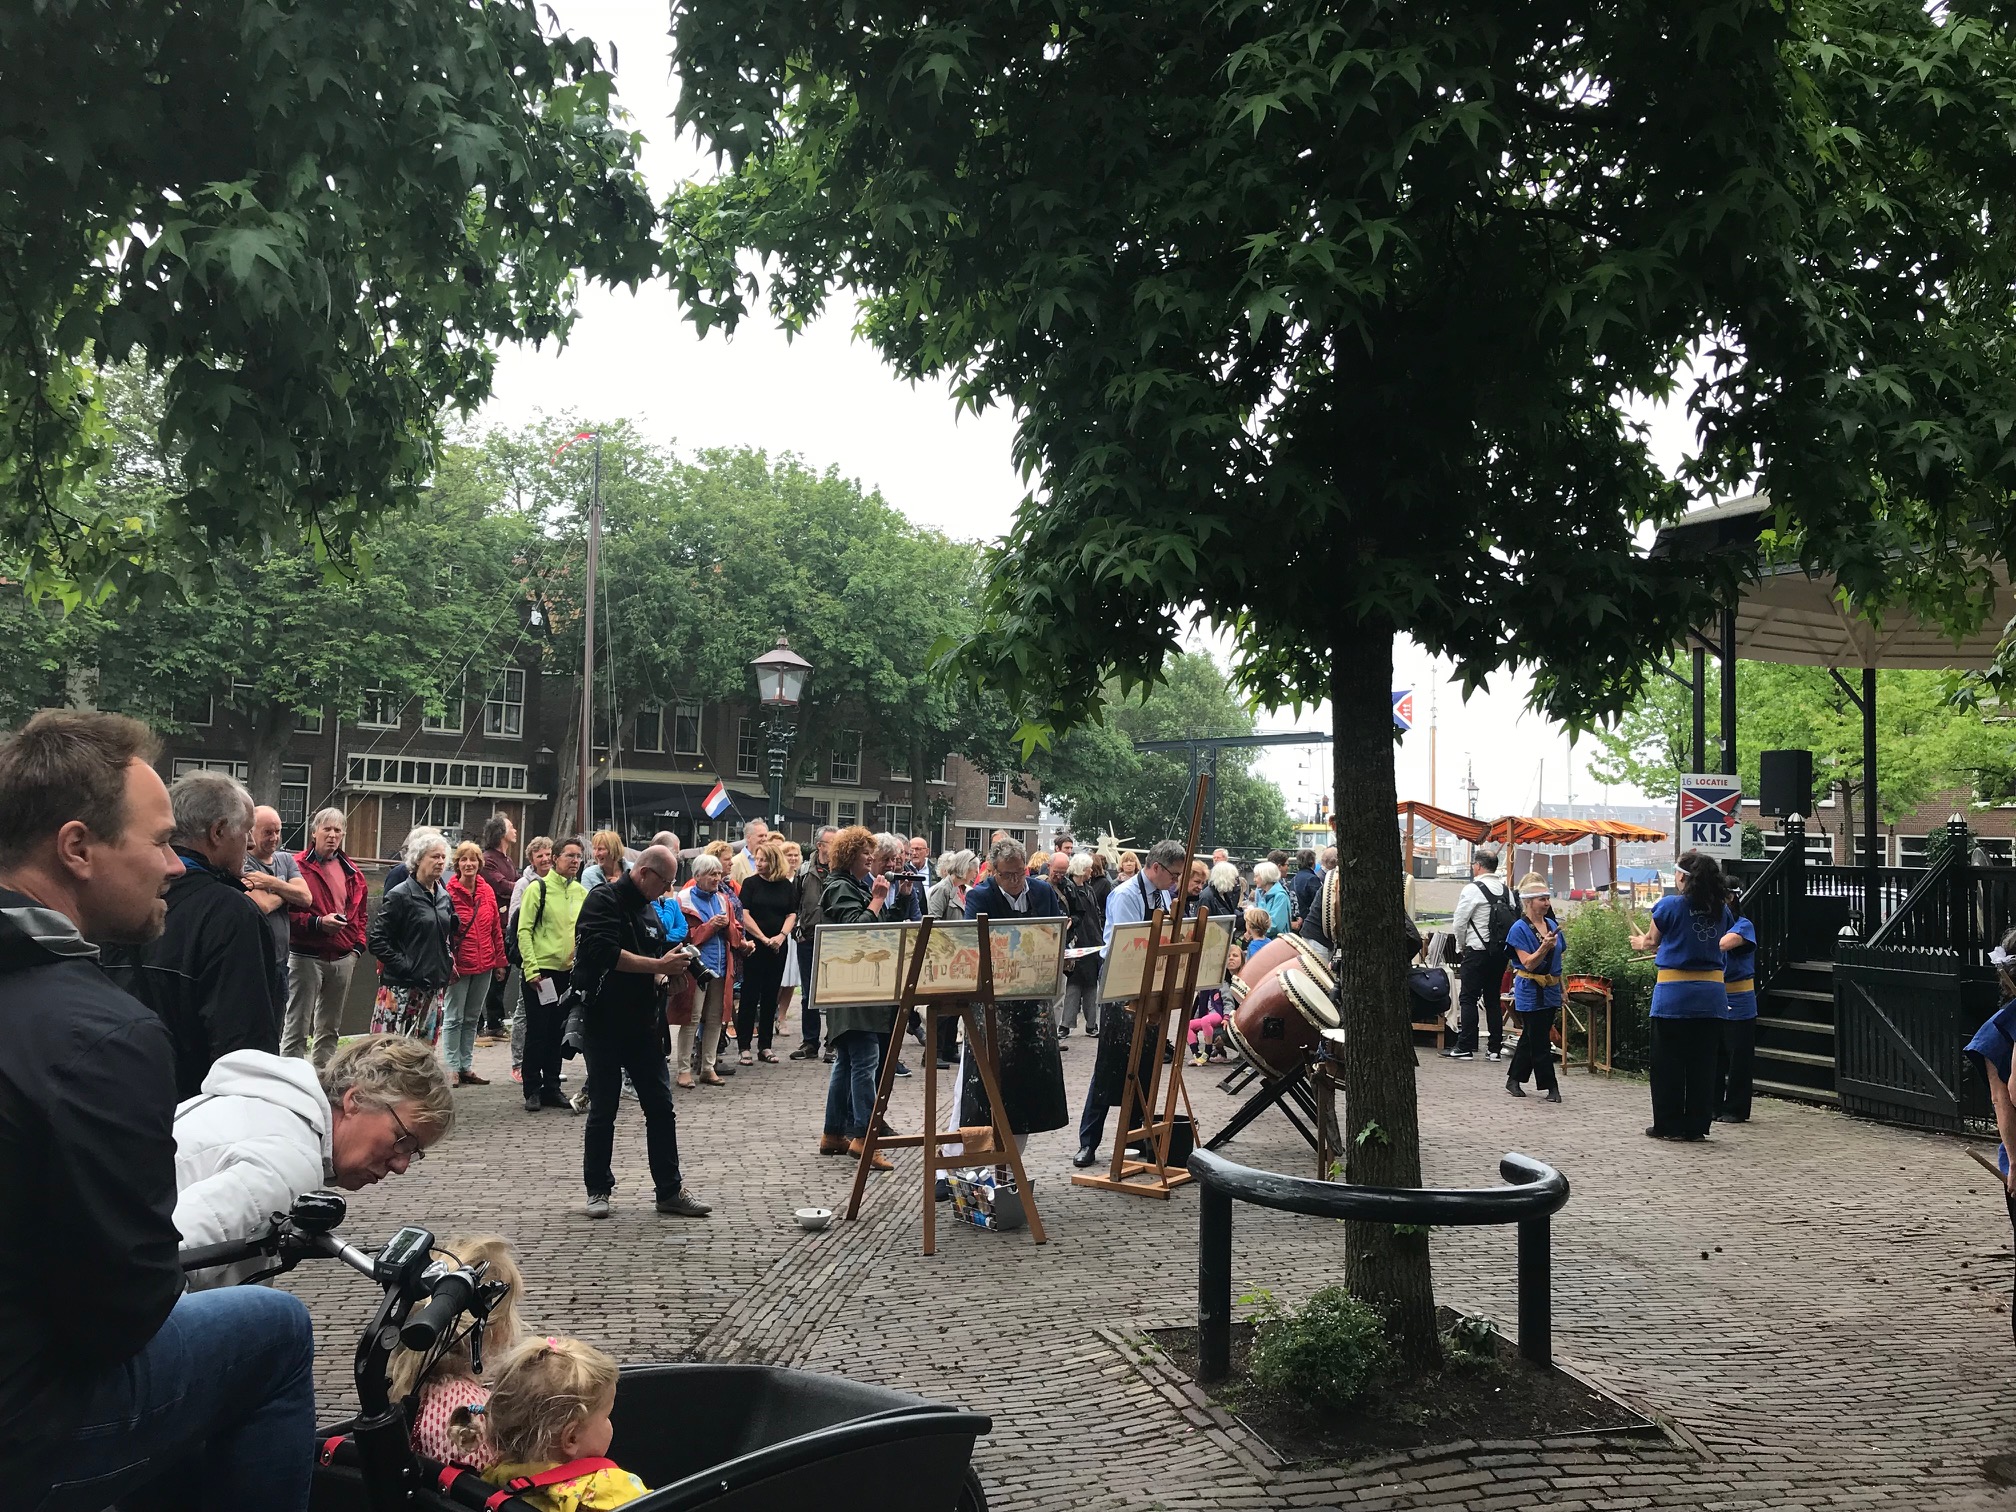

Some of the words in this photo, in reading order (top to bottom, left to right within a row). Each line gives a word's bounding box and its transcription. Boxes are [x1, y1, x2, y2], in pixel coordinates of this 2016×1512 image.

[1682, 778, 1692, 786] 16
[1695, 778, 1728, 786] LOCATIE
[1692, 823, 1732, 843] KIS
